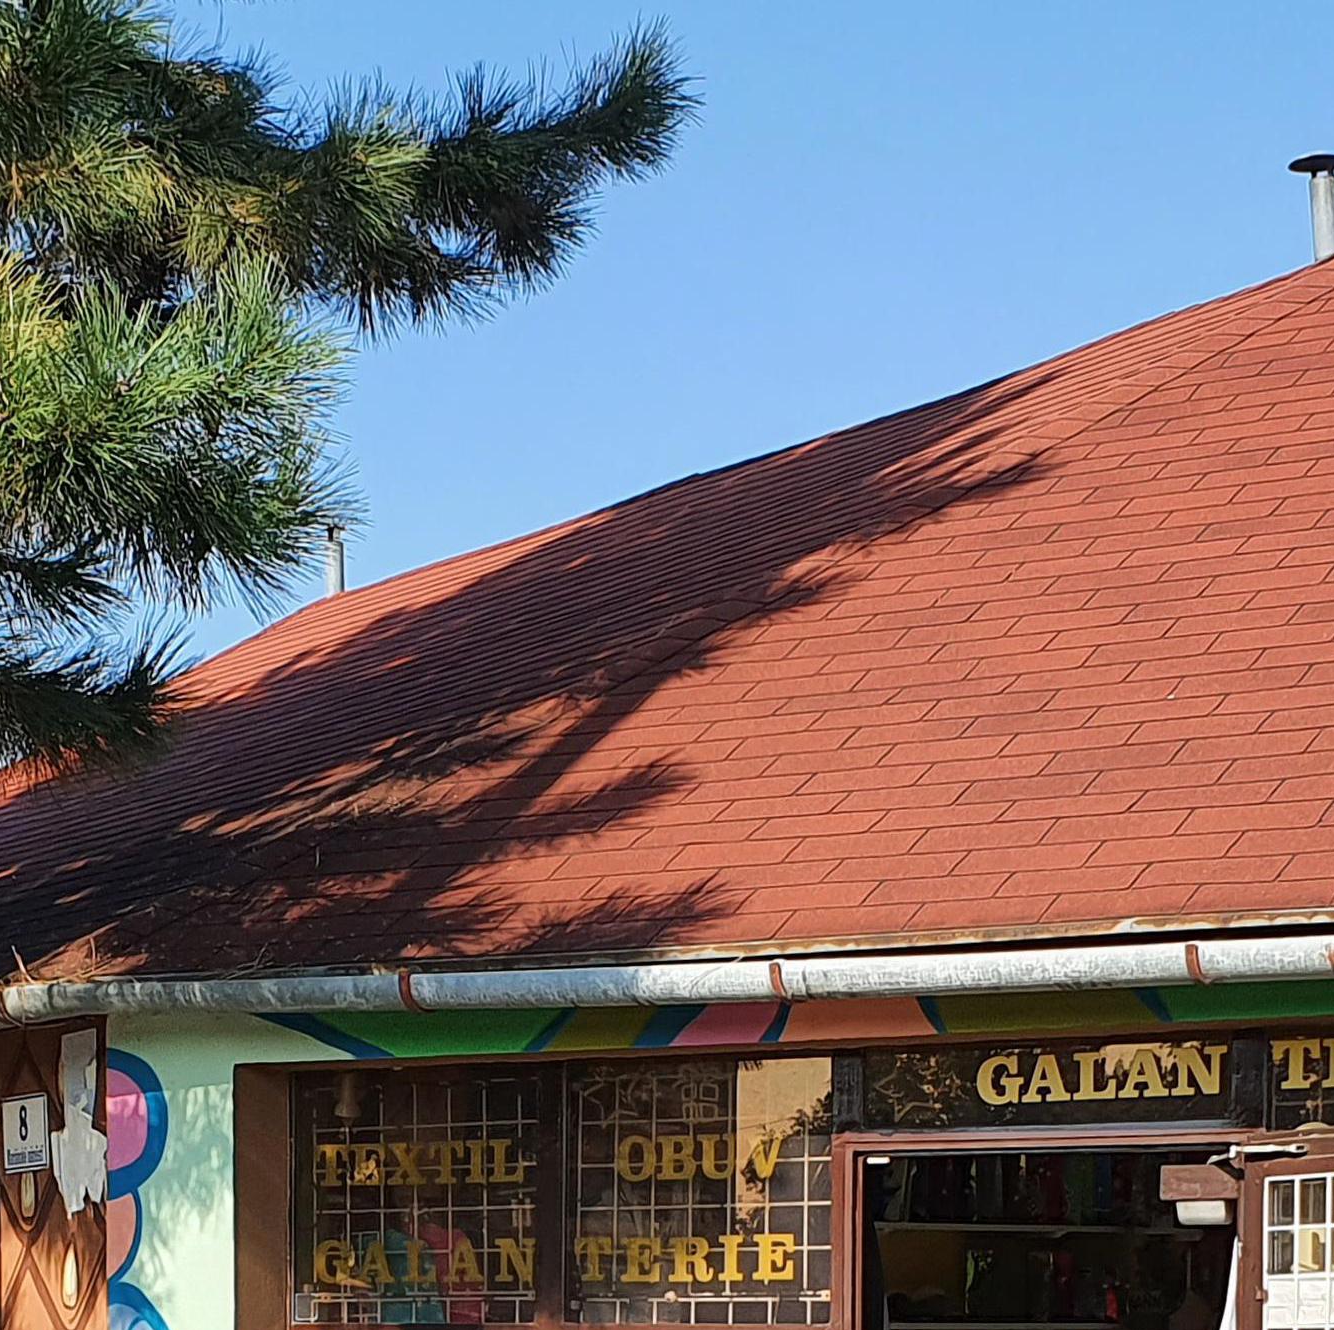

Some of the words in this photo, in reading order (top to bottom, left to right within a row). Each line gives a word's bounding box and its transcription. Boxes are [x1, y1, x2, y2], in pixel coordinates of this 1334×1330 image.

[976, 1043, 1227, 1105] GALAN
[19, 1104, 28, 1141] 8
[313, 1138, 524, 1187] TEXTIL
[616, 1133, 787, 1182] OBUV
[314, 1237, 536, 1285] GALAN
[574, 1232, 796, 1284] TERIE
